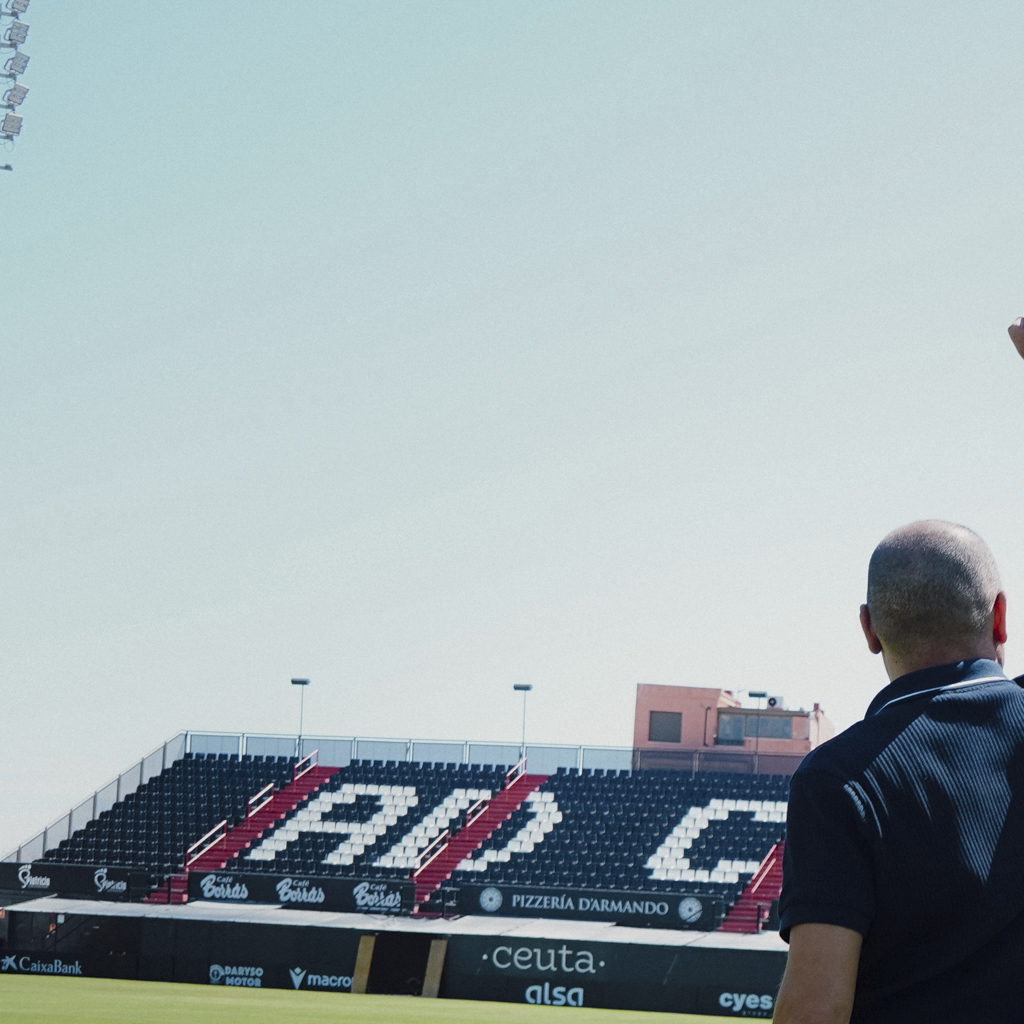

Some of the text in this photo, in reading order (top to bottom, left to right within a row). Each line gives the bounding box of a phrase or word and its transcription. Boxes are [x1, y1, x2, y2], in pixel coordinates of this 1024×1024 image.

[216, 875, 234, 884] Café
[292, 879, 310, 888] Café
[370, 883, 388, 891] Café
[511, 893, 669, 916] PIZZERÍA D'ARMANDO
[19, 956, 82, 975] CaixaBank
[224, 966, 264, 976] DARYSO
[225, 976, 262, 987] MOTOR
[307, 973, 354, 988] macro
[525, 982, 584, 1007] alsa
[719, 992, 773, 1012] cyes
